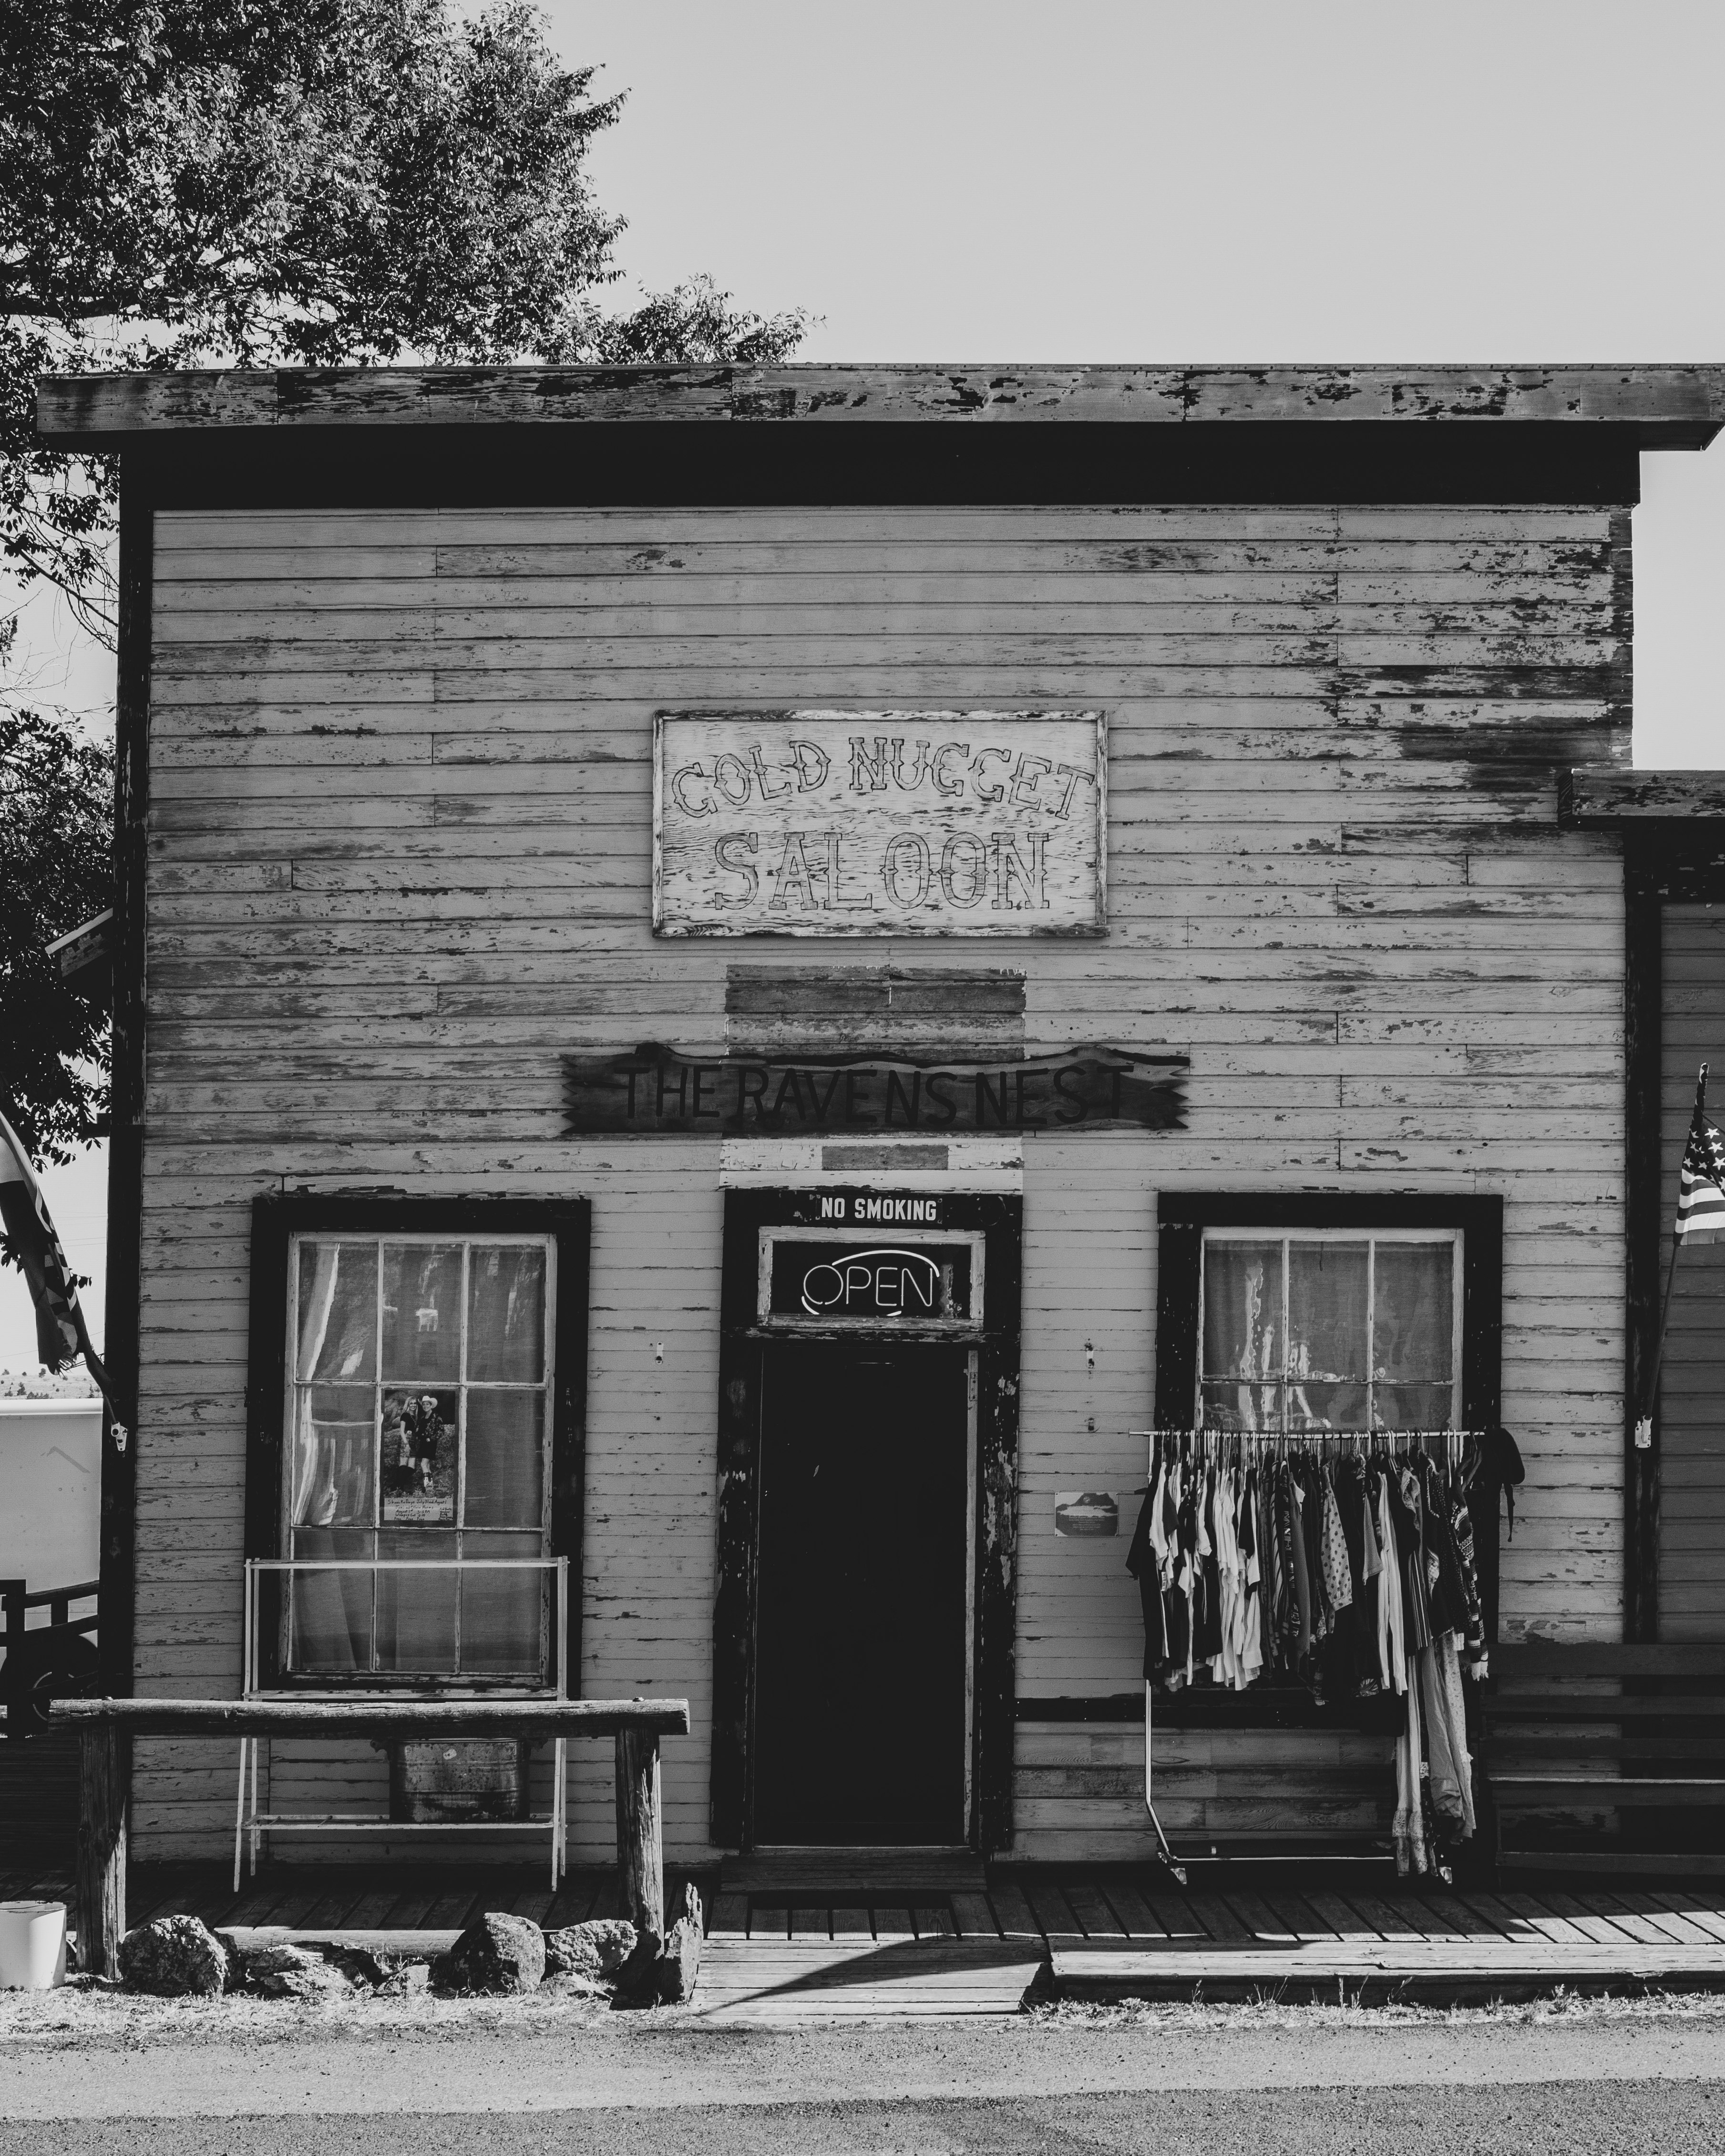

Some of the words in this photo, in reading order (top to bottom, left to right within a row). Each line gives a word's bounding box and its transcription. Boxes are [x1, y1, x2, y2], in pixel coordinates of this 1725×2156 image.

[671, 740, 832, 818] GOLD
[848, 737, 1096, 820] NUGGET
[714, 832, 1050, 911] SALOON
[613, 1065, 723, 1119] THE
[737, 1066, 958, 1126] RAVENS
[975, 1065, 1134, 1125] NEST
[821, 1197, 845, 1218] NO
[854, 1198, 936, 1221] SMOKING
[803, 1264, 933, 1307] OPEN
